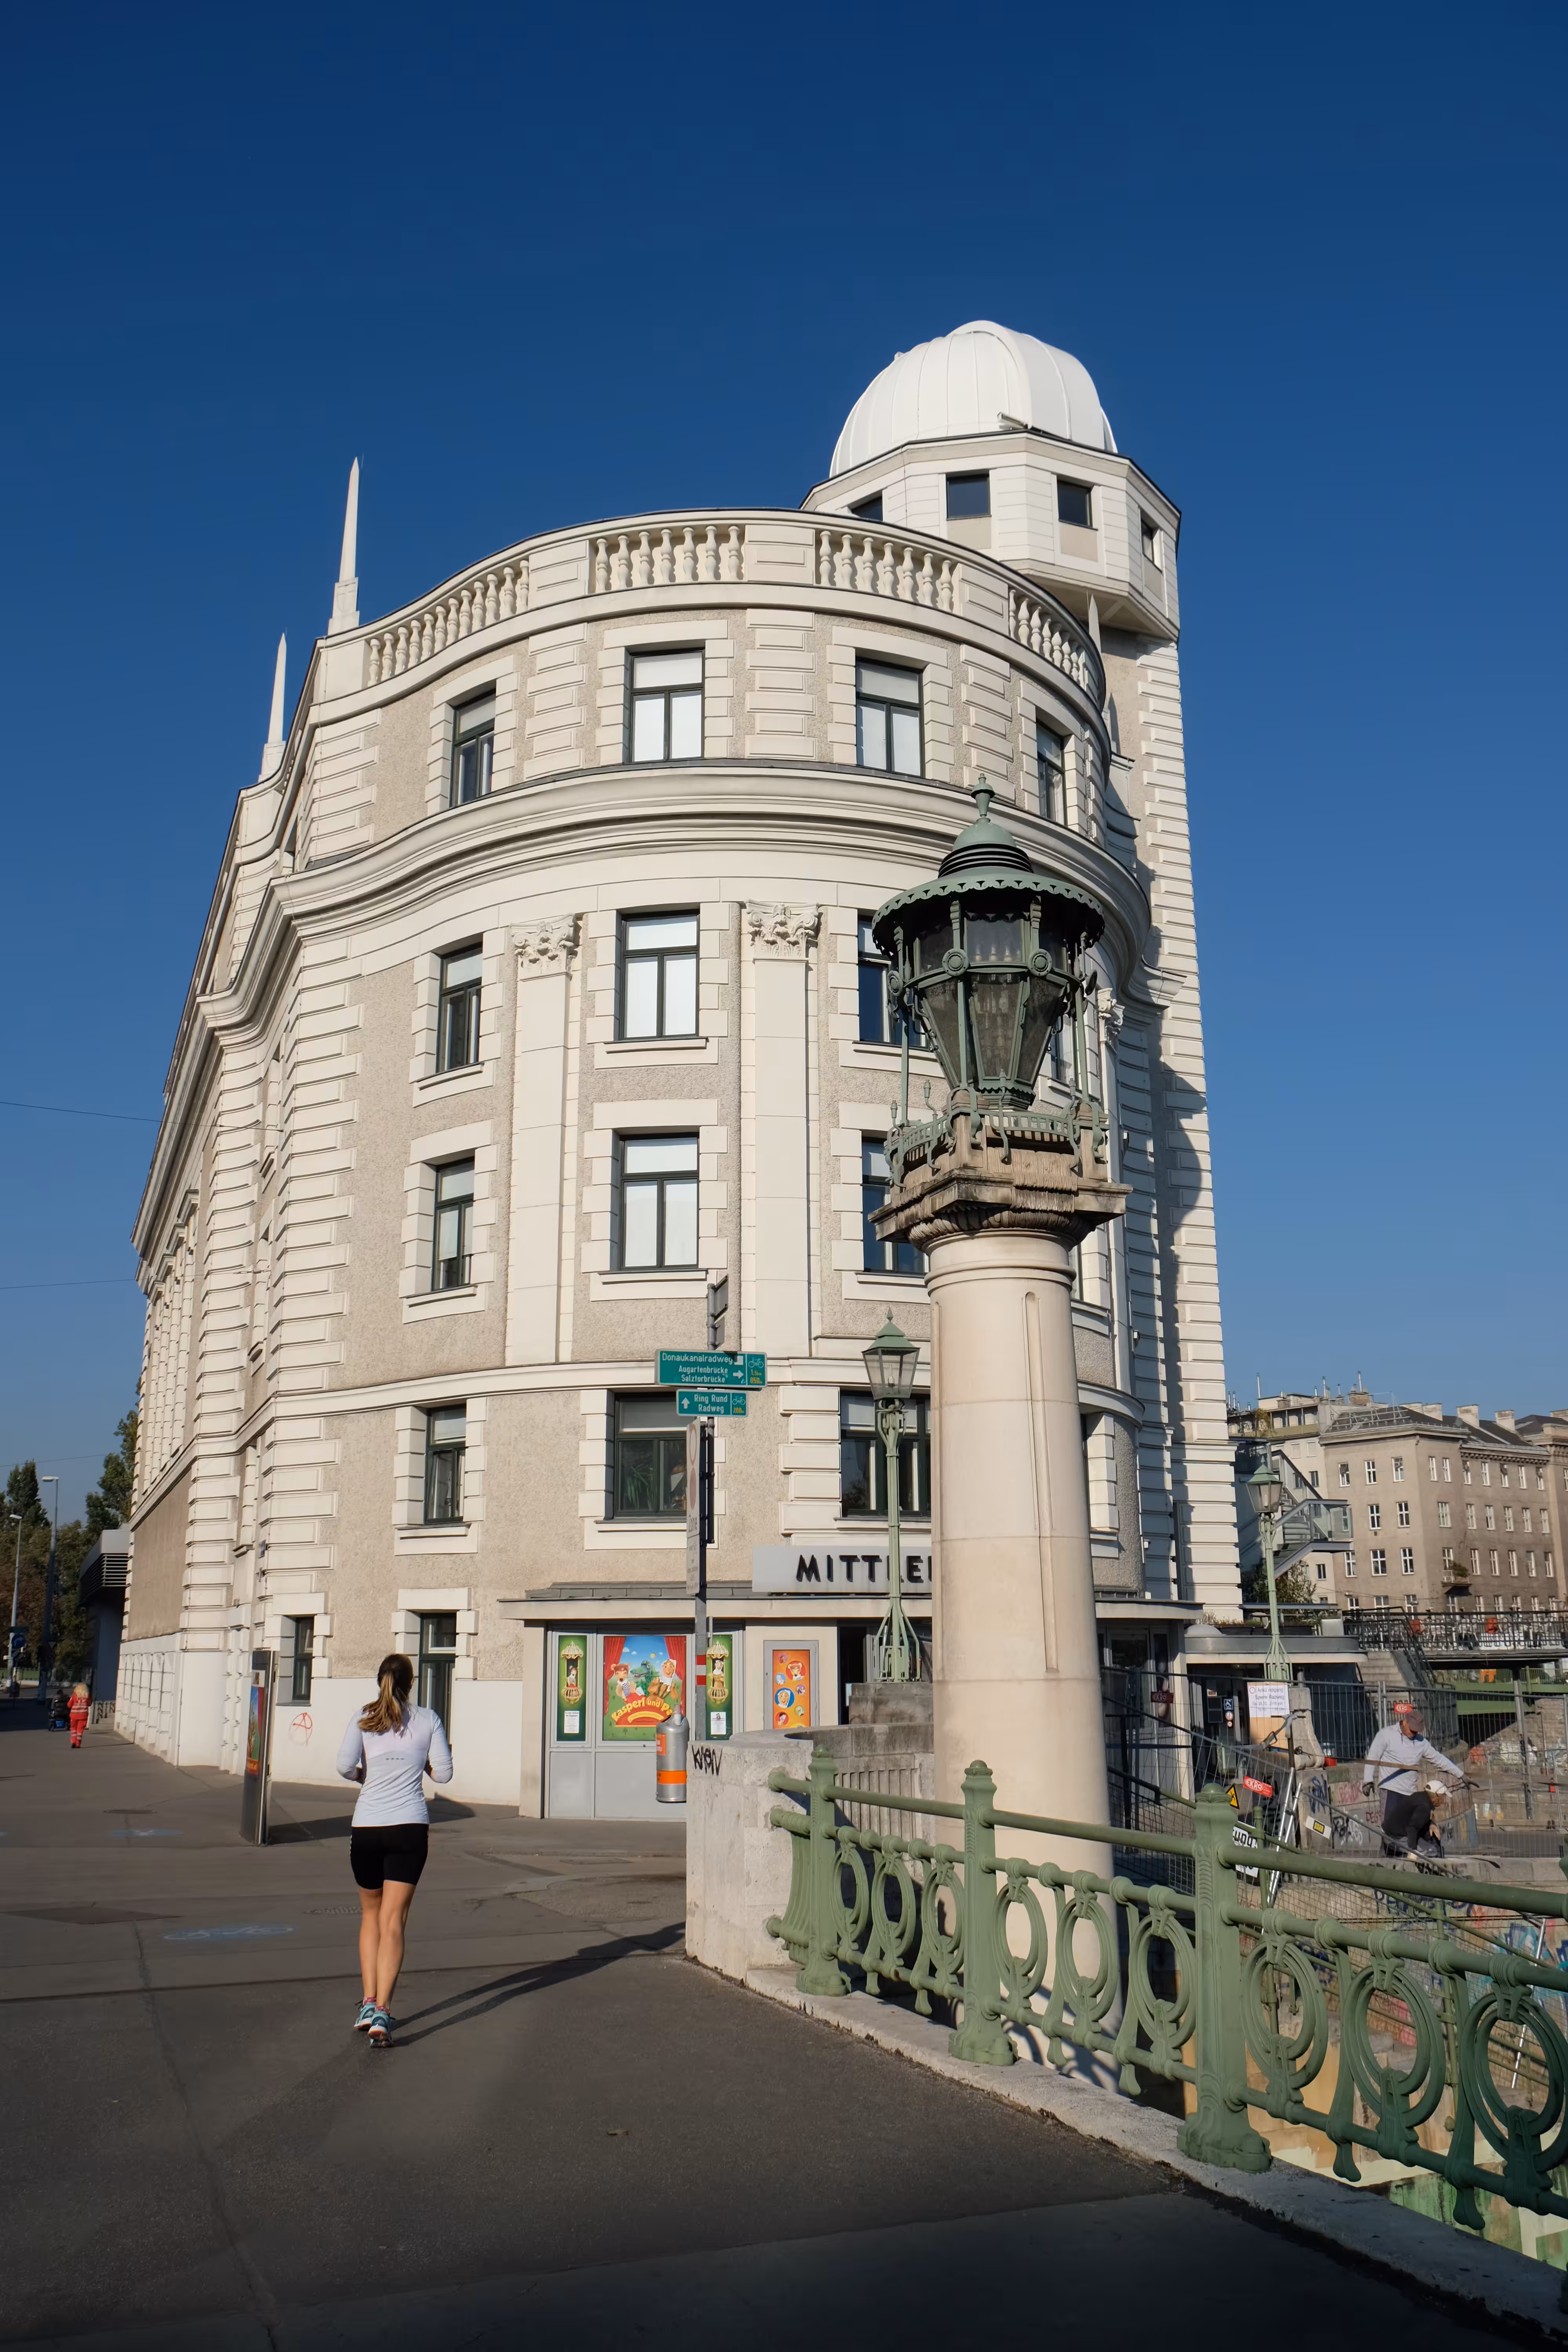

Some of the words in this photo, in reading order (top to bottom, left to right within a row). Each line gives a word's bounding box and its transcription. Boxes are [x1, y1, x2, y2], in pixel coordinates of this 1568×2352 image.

[662, 1352, 733, 1365] Donaukanalradweg
[679, 1365, 728, 1374] Augartenbrücke
[681, 1374, 725, 1383] Salztorbrücke
[694, 1394, 709, 1404] Ring
[711, 1394, 728, 1403] Rund
[698, 1404, 724, 1414] Radweg
[612, 1697, 645, 1722] Kasperl
[1247, 1780, 1262, 1789] EKRO
